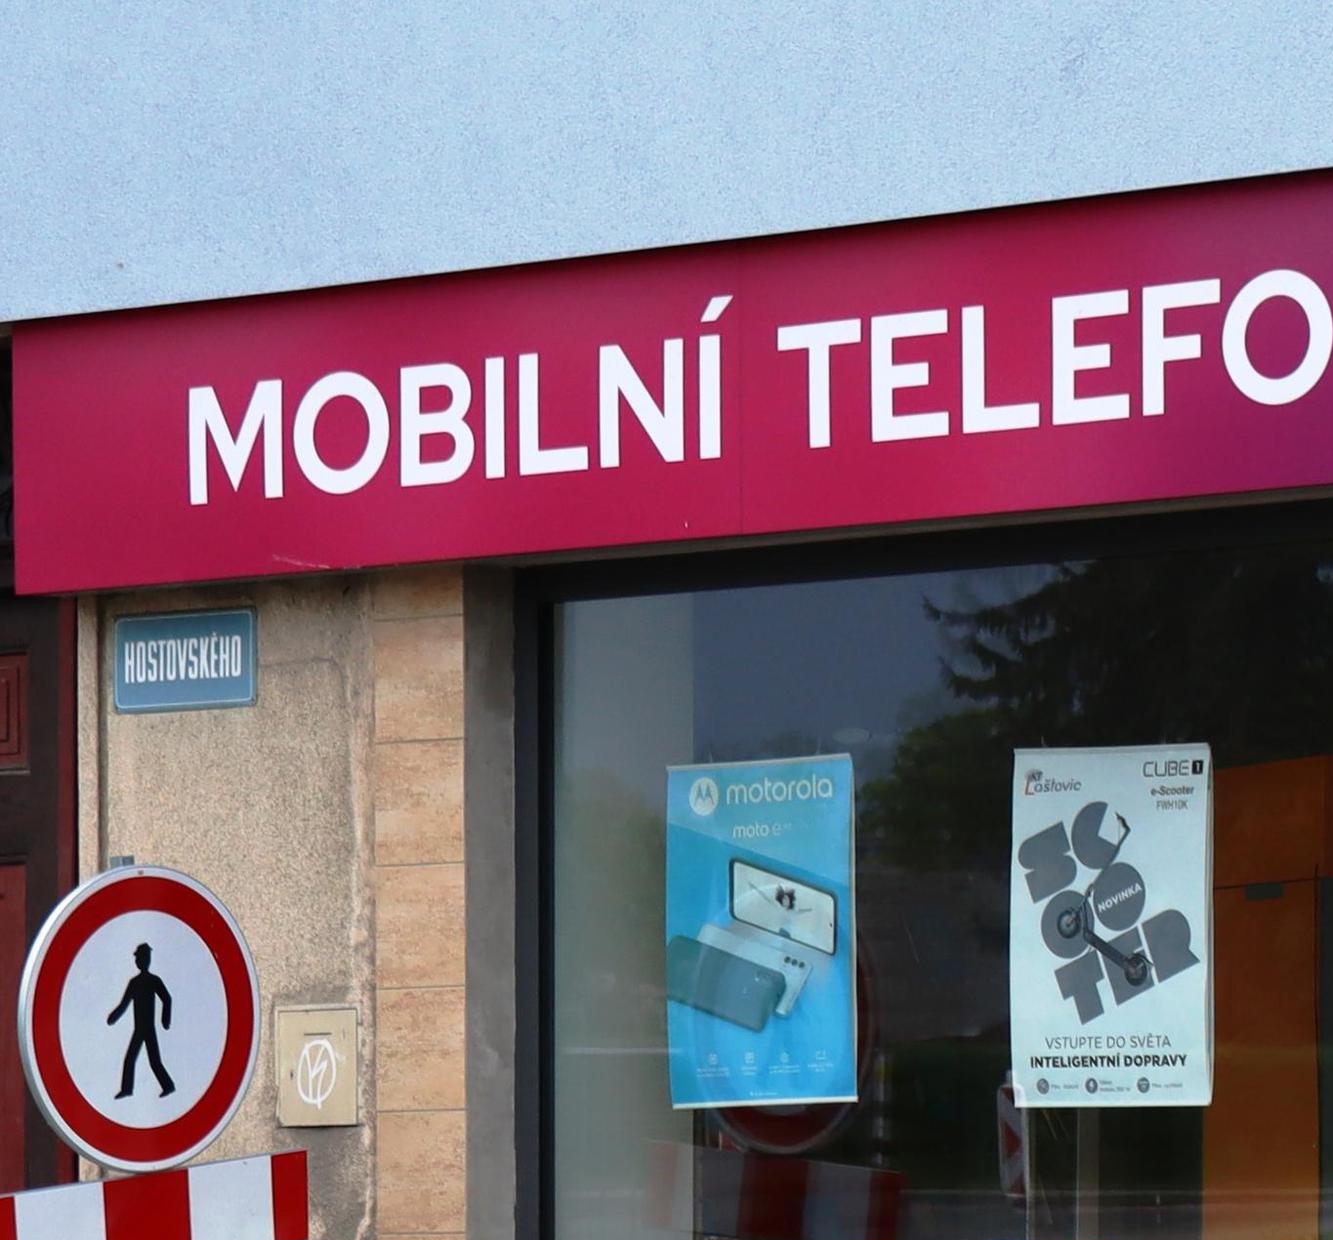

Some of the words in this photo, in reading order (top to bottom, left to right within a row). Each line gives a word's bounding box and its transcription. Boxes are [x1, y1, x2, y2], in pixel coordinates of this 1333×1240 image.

[187, 294, 734, 506] MOBILNÍ
[124, 631, 242, 684] HOSTOVSKÉHO
[1143, 760, 1190, 777] CUBE
[726, 773, 833, 805] motorola
[733, 821, 769, 839] moto
[1097, 882, 1143, 914] NOVINKA
[1045, 1035, 1101, 1050] VSTUPTE
[1107, 1036, 1126, 1049] DO
[1130, 1033, 1171, 1049] SVĚTA
[1030, 1052, 1120, 1069] INTELIGENTNÍ
[1124, 1054, 1187, 1067] DOPRAVY
